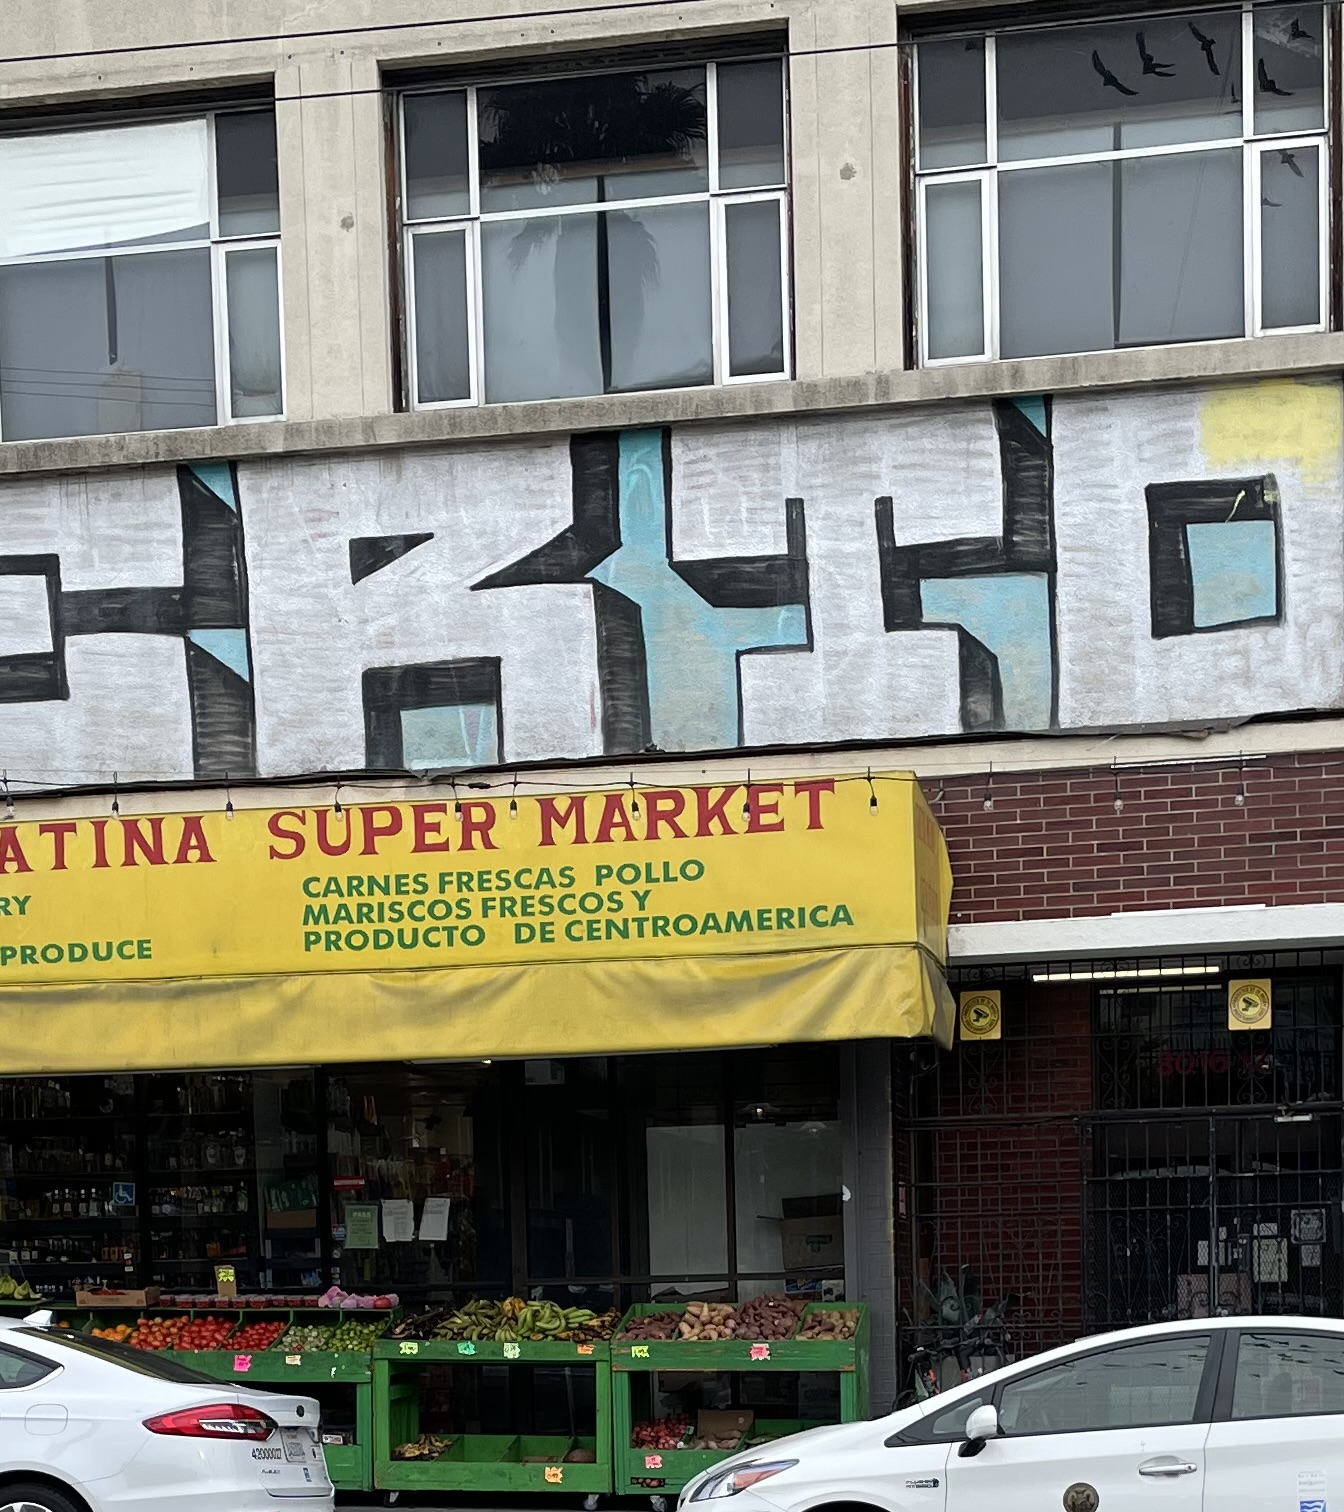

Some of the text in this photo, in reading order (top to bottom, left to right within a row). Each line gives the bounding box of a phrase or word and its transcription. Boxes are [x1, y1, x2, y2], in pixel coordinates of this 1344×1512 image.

[268, 801, 501, 860] SUPER
[538, 778, 837, 848] MARKET
[301, 858, 706, 900] CARNES FRESCAS POLLO
[301, 888, 653, 927] MARISCOS FRESCOS Y
[302, 903, 856, 953] PRODUCTO DE CENTROAMERICA
[0, 938, 154, 968] PRODUCE
[352, 1211, 372, 1219] PASS
